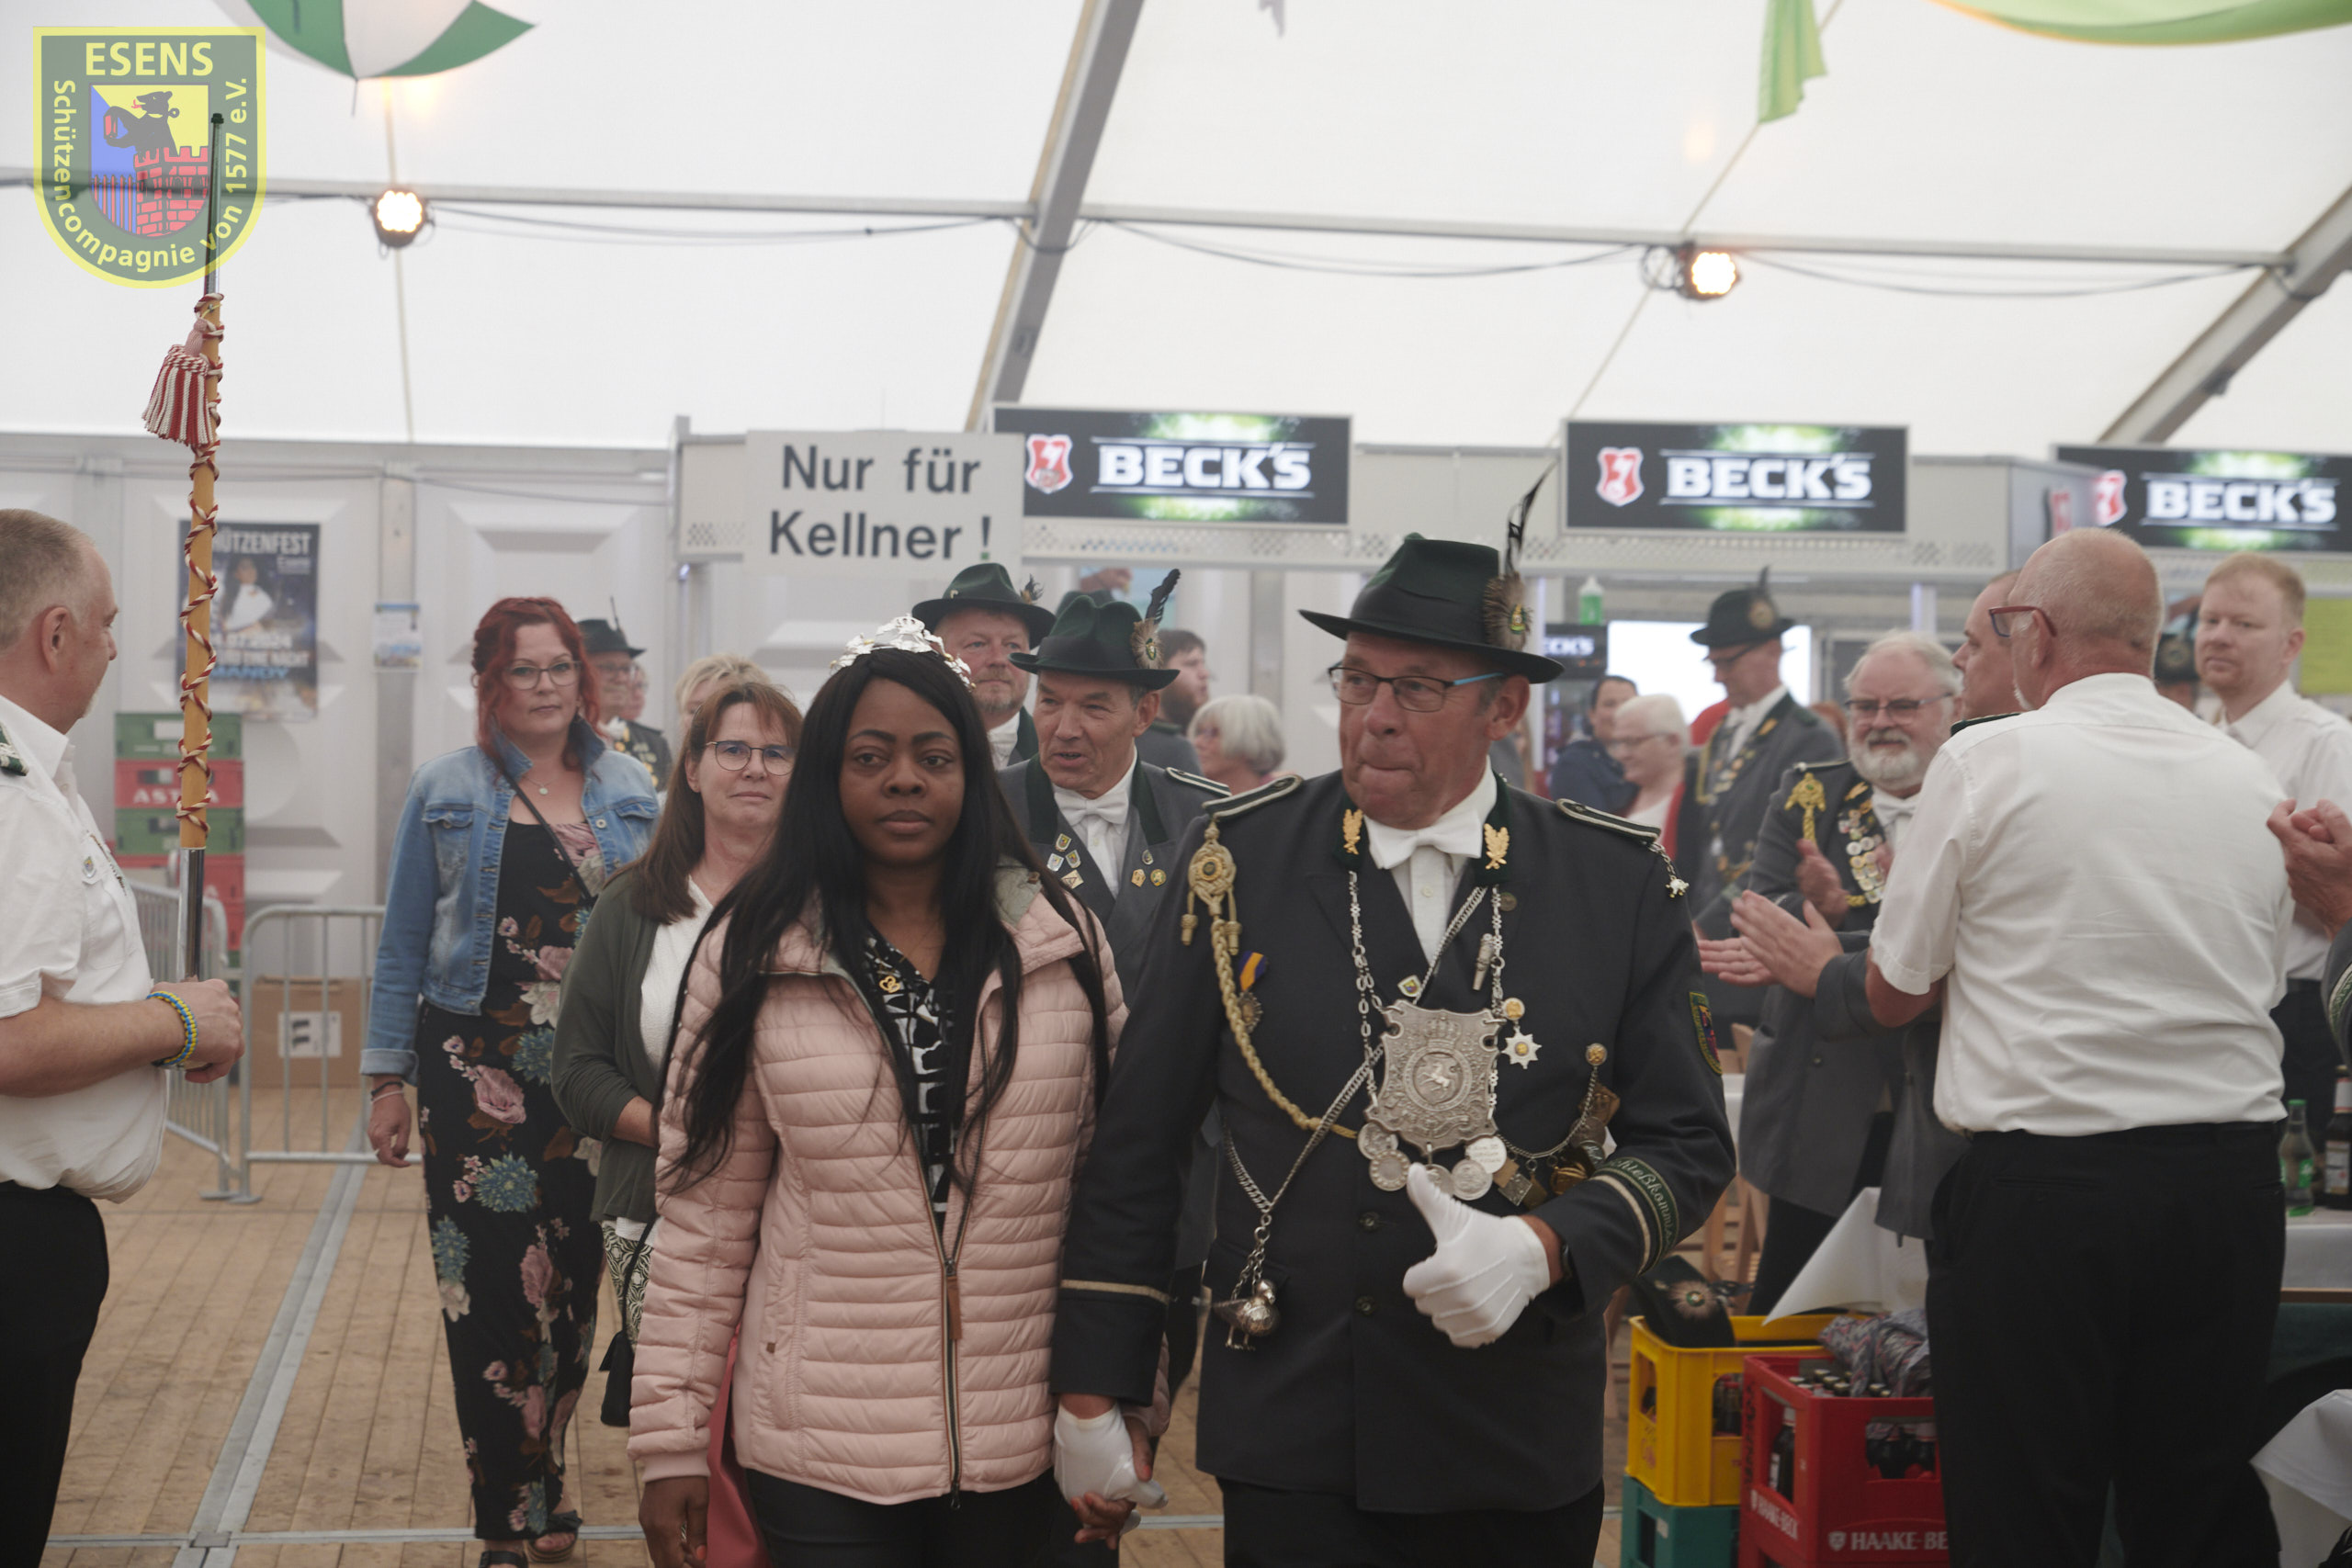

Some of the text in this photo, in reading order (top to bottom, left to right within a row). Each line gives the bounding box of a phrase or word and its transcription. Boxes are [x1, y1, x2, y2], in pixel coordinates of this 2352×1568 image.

[783, 445, 980, 493] Nur für
[1098, 443, 1312, 490] BECK'S
[1667, 454, 1872, 500] BECK'S
[2146, 479, 2336, 523] BECK'S
[770, 510, 962, 559] Kellner
[133, 788, 220, 805] ASTA
[1850, 1531, 1948, 1551] HAAKE-BE
